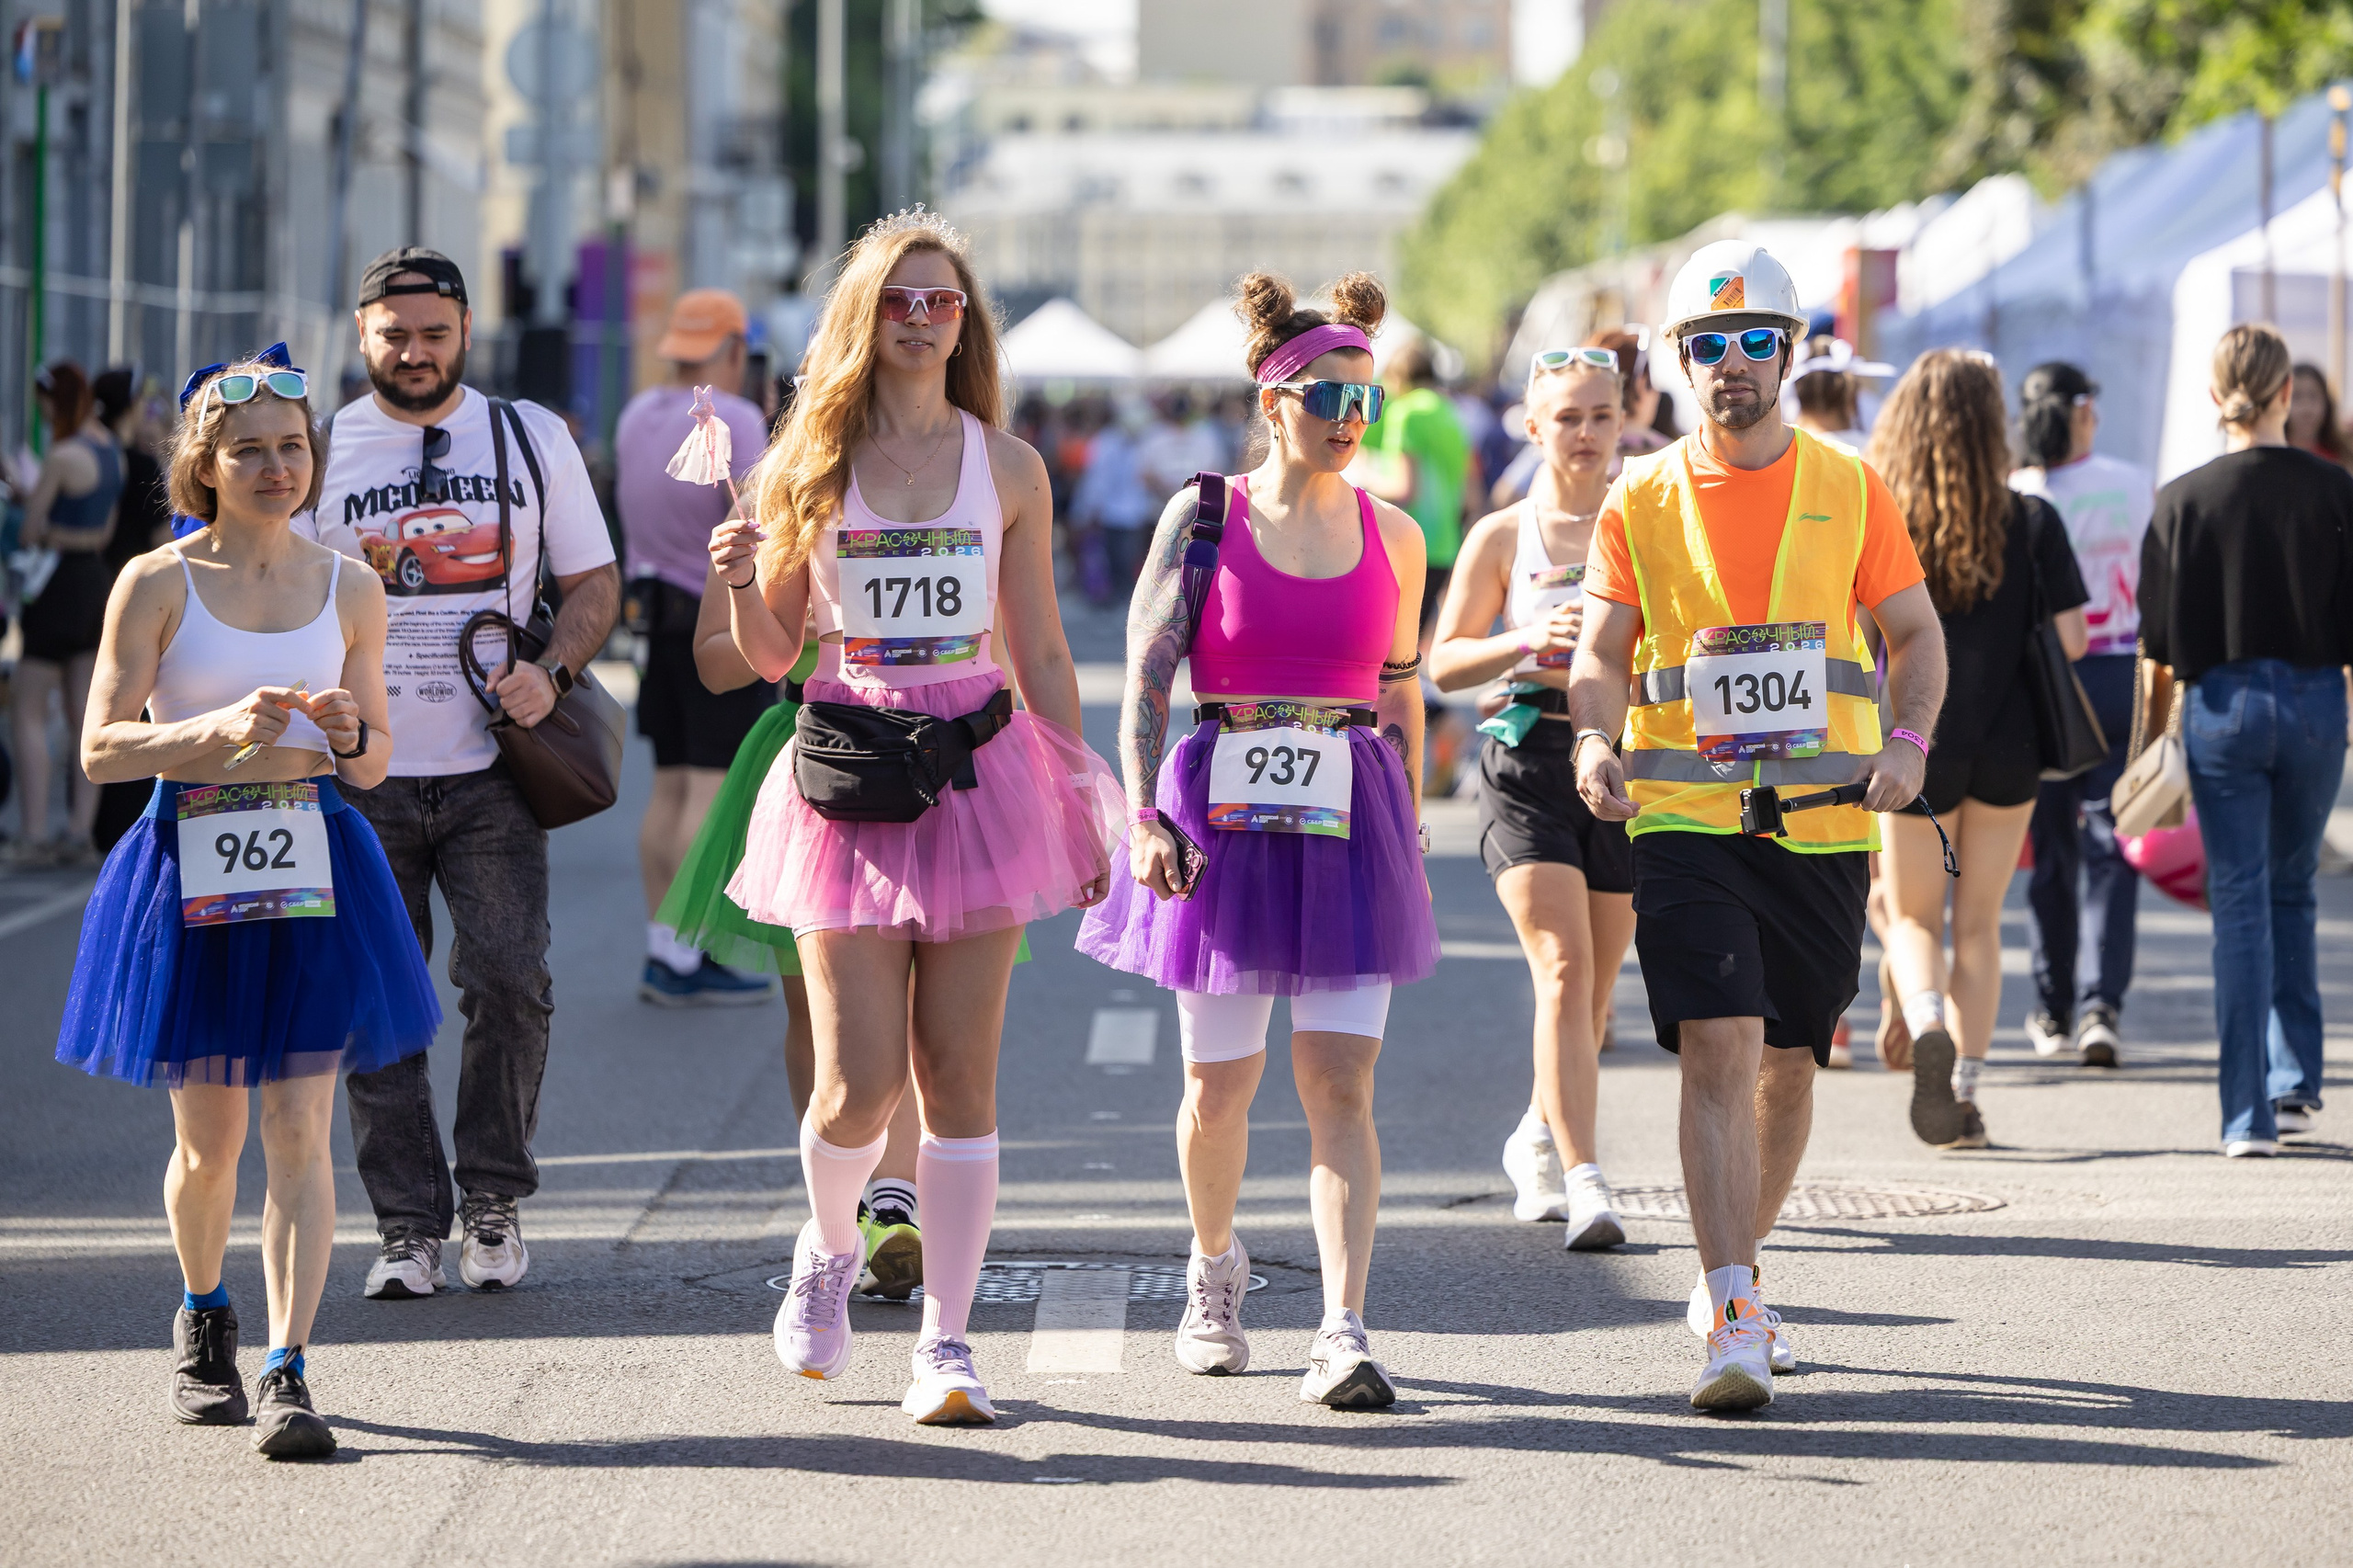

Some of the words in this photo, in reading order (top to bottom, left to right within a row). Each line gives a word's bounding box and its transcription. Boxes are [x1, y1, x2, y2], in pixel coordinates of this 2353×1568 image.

[849, 529, 972, 548] КРАСОЧНЫЙ
[921, 546, 982, 557] 2026
[864, 575, 962, 619] 1718
[1701, 623, 1815, 646] КРАСОЧНЫЙ
[1769, 640, 1824, 653] 2026
[418, 687, 454, 696] WORLDWIDE
[1714, 670, 1812, 715] 1304
[1293, 721, 1347, 740] 2026
[1245, 745, 1321, 787] 937
[188, 784, 308, 809] КРАСОЧНЫЙ
[215, 828, 296, 874] 962
